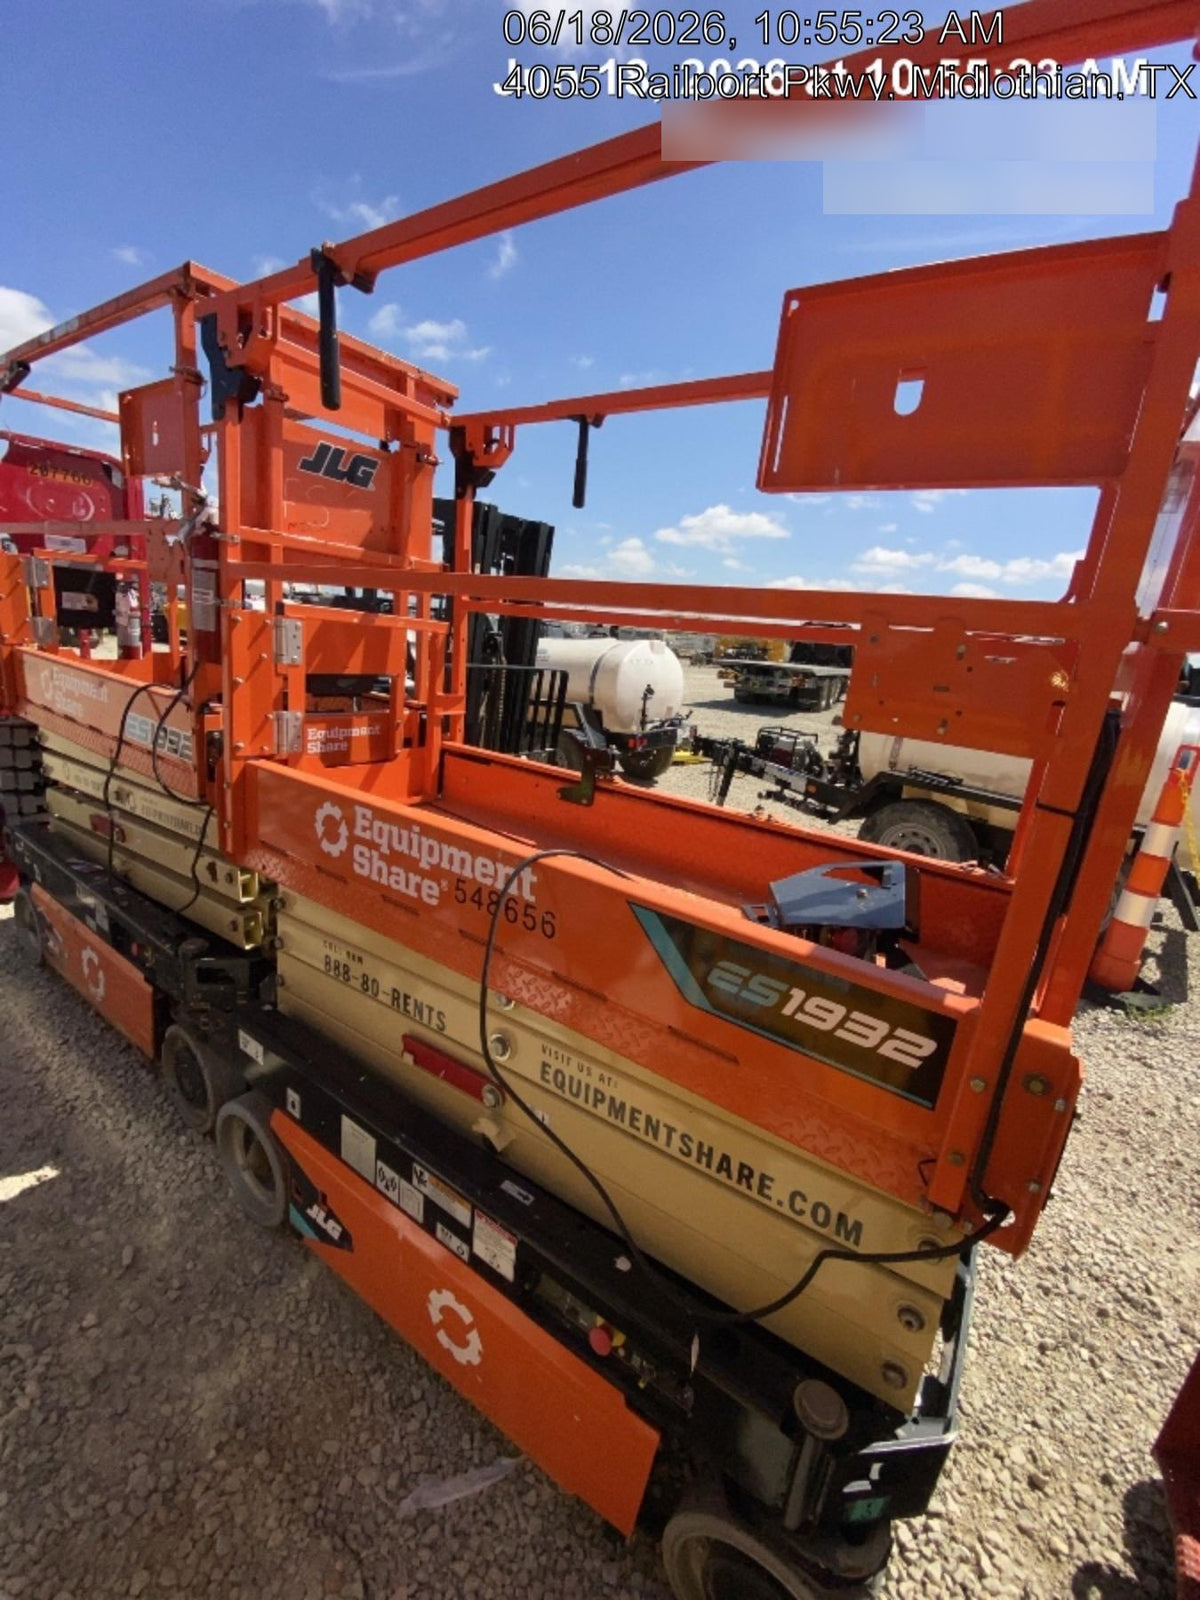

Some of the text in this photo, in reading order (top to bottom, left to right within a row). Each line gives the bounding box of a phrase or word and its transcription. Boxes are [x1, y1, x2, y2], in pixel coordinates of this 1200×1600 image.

[297, 440, 381, 490] JLG
[307, 727, 380, 741] Equipment
[307, 741, 348, 754] Share
[353, 845, 440, 906] Share
[354, 805, 538, 901] Equipment
[454, 878, 556, 939] 548656
[324, 954, 446, 1032] 888-80-RENTS
[707, 961, 938, 1068] ES1932
[541, 1043, 572, 1067] VISIT
[577, 1061, 593, 1077] US
[540, 1060, 864, 1248] EQUIPMENTSHARE.COM
[306, 1203, 342, 1240] JLG
